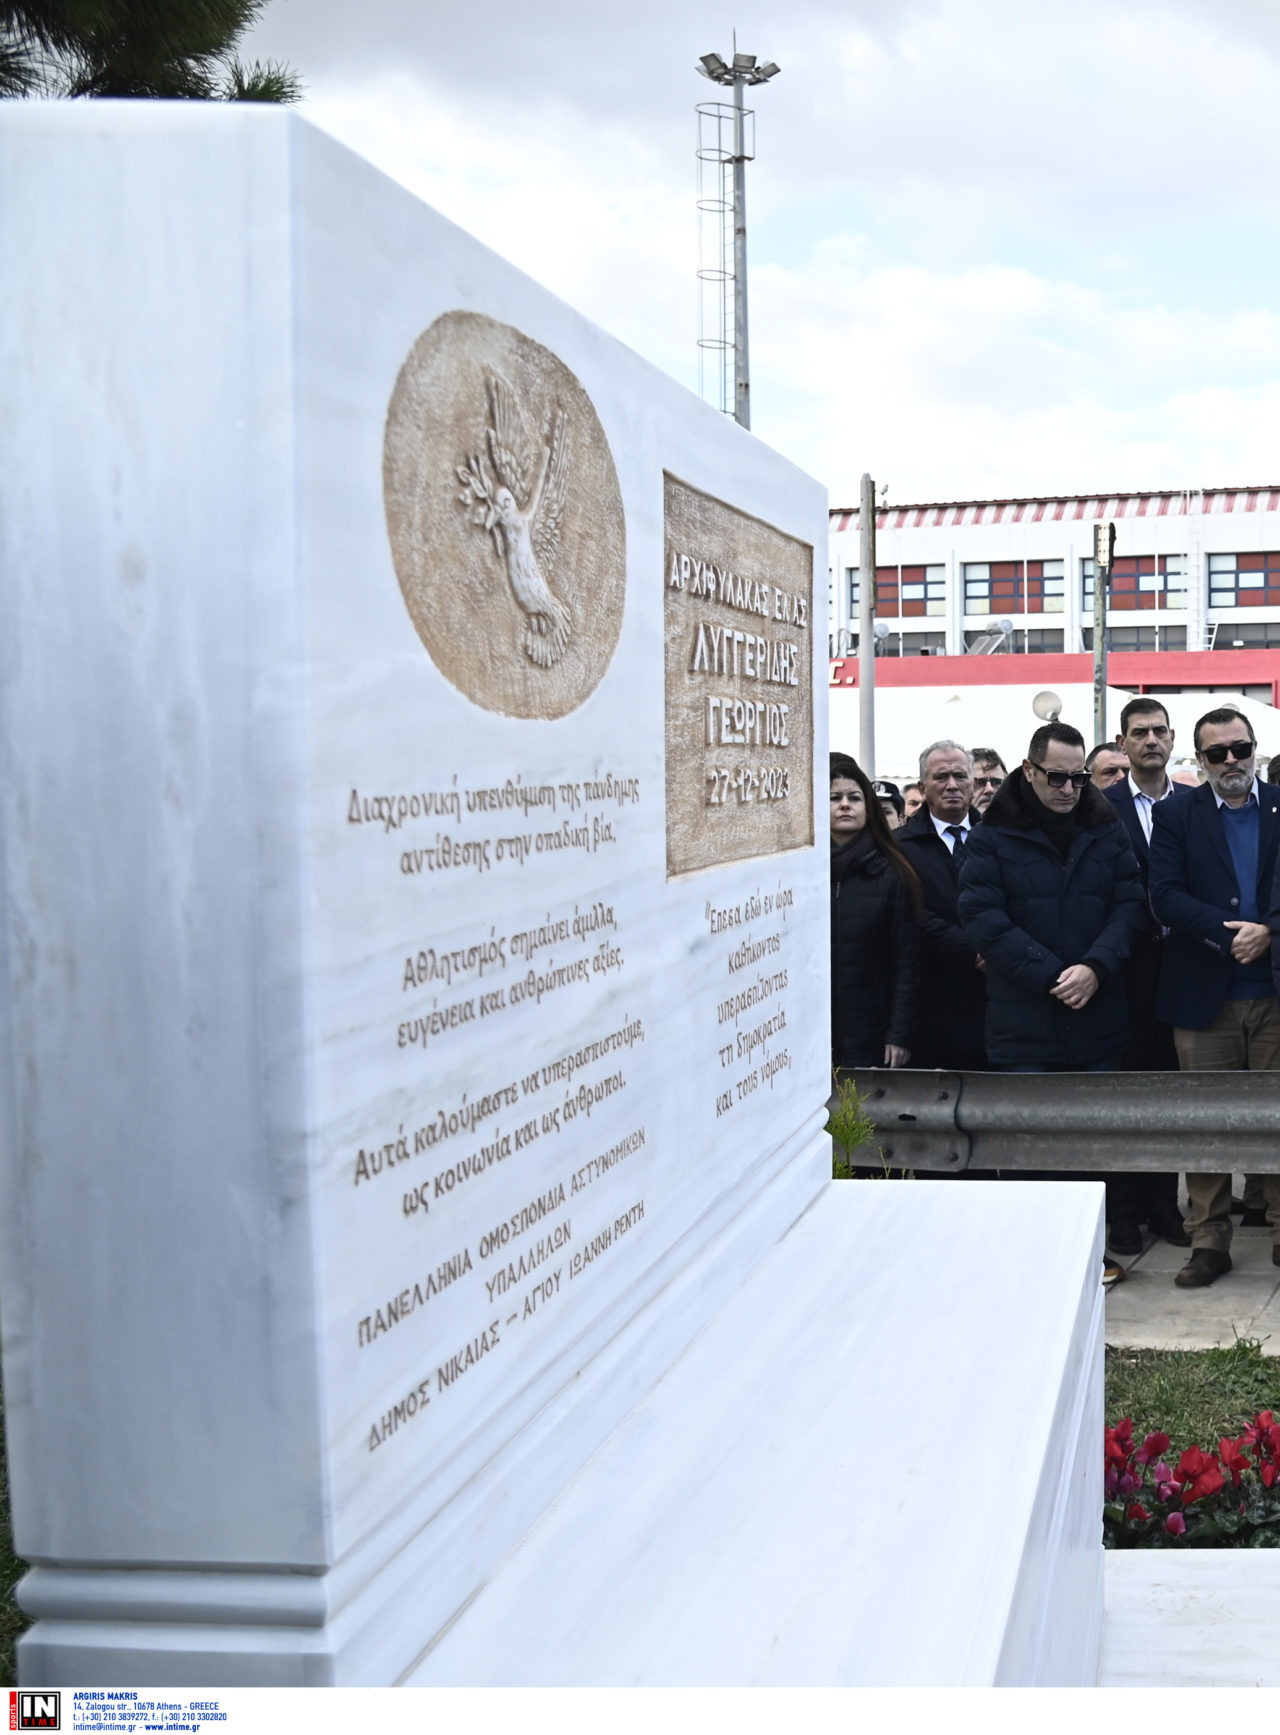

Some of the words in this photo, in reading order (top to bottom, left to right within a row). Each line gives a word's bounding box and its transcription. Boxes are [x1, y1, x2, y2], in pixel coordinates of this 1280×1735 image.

[670, 552, 769, 616] ΑΡΧΙΦΥΛΑΚΑΣ
[693, 623, 799, 685] ΛΥΓΓΕΡΙΔΗΣ
[706, 697, 789, 746] ΓΕΩΡΓΙΟΣ
[347, 774, 461, 833] Διαχρονική
[466, 774, 555, 817] υπενθύμιση
[559, 784, 580, 811] της
[584, 769, 640, 805] πάνδημης
[710, 767, 790, 803] 27-12-2023
[400, 833, 491, 874] αντίθεσης
[496, 833, 532, 865] στην
[535, 813, 590, 853] οπαδική
[745, 888, 761, 921] εδώ
[764, 894, 773, 915] εν
[776, 879, 793, 921] ώρα
[403, 926, 506, 991] Αθλητισμός
[510, 912, 570, 961] σημαίνει
[728, 933, 780, 975] καθήκοντος
[397, 998, 475, 1050] ευγένεια
[480, 988, 506, 1018] και
[510, 959, 589, 1004] ανθρώπινες
[717, 969, 788, 1028] υπερασπίζοντας
[719, 1045, 733, 1068] τη
[737, 1002, 786, 1065] δημοκρατία
[716, 1089, 733, 1118] και
[736, 1069, 758, 1101] τους
[354, 1124, 410, 1186] Αυτά
[414, 1093, 518, 1154] καλούμαστε
[522, 1072, 540, 1097] να
[402, 1183, 429, 1218] ως
[434, 1128, 511, 1198] κοινωνία
[515, 1119, 539, 1152] και
[542, 1108, 560, 1134] ως
[357, 1248, 472, 1348] ΠΑΝΕΛΛΗΝΙΑ
[480, 1183, 566, 1259] ΟΜΟΣΠΟΝΔΙΑ
[570, 1127, 646, 1197] ΑΣΤΥΝΟΜΙΚΩΝ
[484, 1219, 572, 1303] ΥΠΑΛΛΗΛΩΝ
[369, 1379, 431, 1452] ΔΗΜΟΣ
[436, 1319, 500, 1392] ΝΙΚΑΙΑΣ
[523, 1267, 563, 1321] ΑΓΙΟΥ
[569, 1225, 612, 1280] ΙΩΑΝΝΗ
[614, 1200, 645, 1242] ΡΕΝΤΗ
